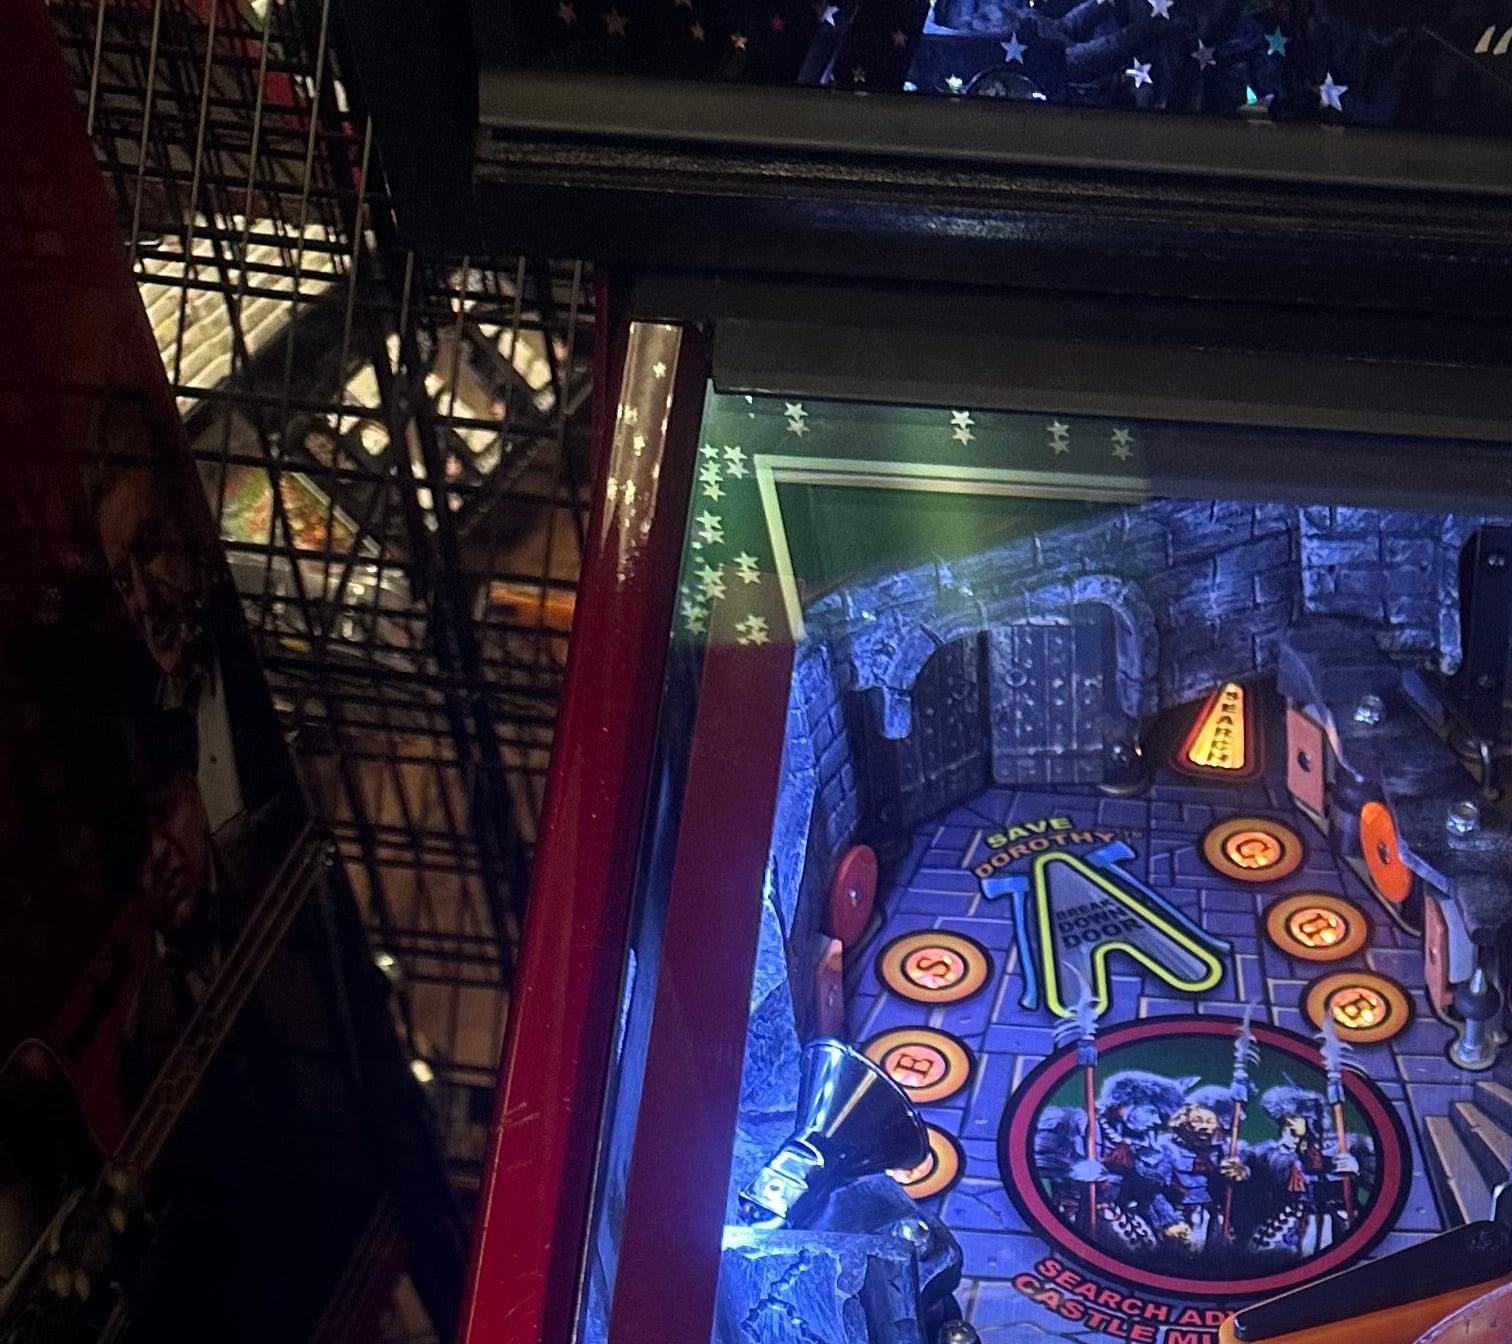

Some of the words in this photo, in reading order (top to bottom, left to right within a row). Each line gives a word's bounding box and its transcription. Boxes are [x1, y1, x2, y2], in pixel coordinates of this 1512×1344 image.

[1207, 690, 1240, 765] SEARCH
[986, 815, 1074, 849] SAVE
[974, 831, 1116, 879] DOROTHY
[1055, 898, 1115, 920] BREAK
[1058, 906, 1131, 933] DOWN
[1062, 917, 1146, 949] DOOR
[917, 955, 953, 978] S
[1037, 1259, 1167, 1322] SEARCH
[1013, 1274, 1156, 1344] CASTLE
